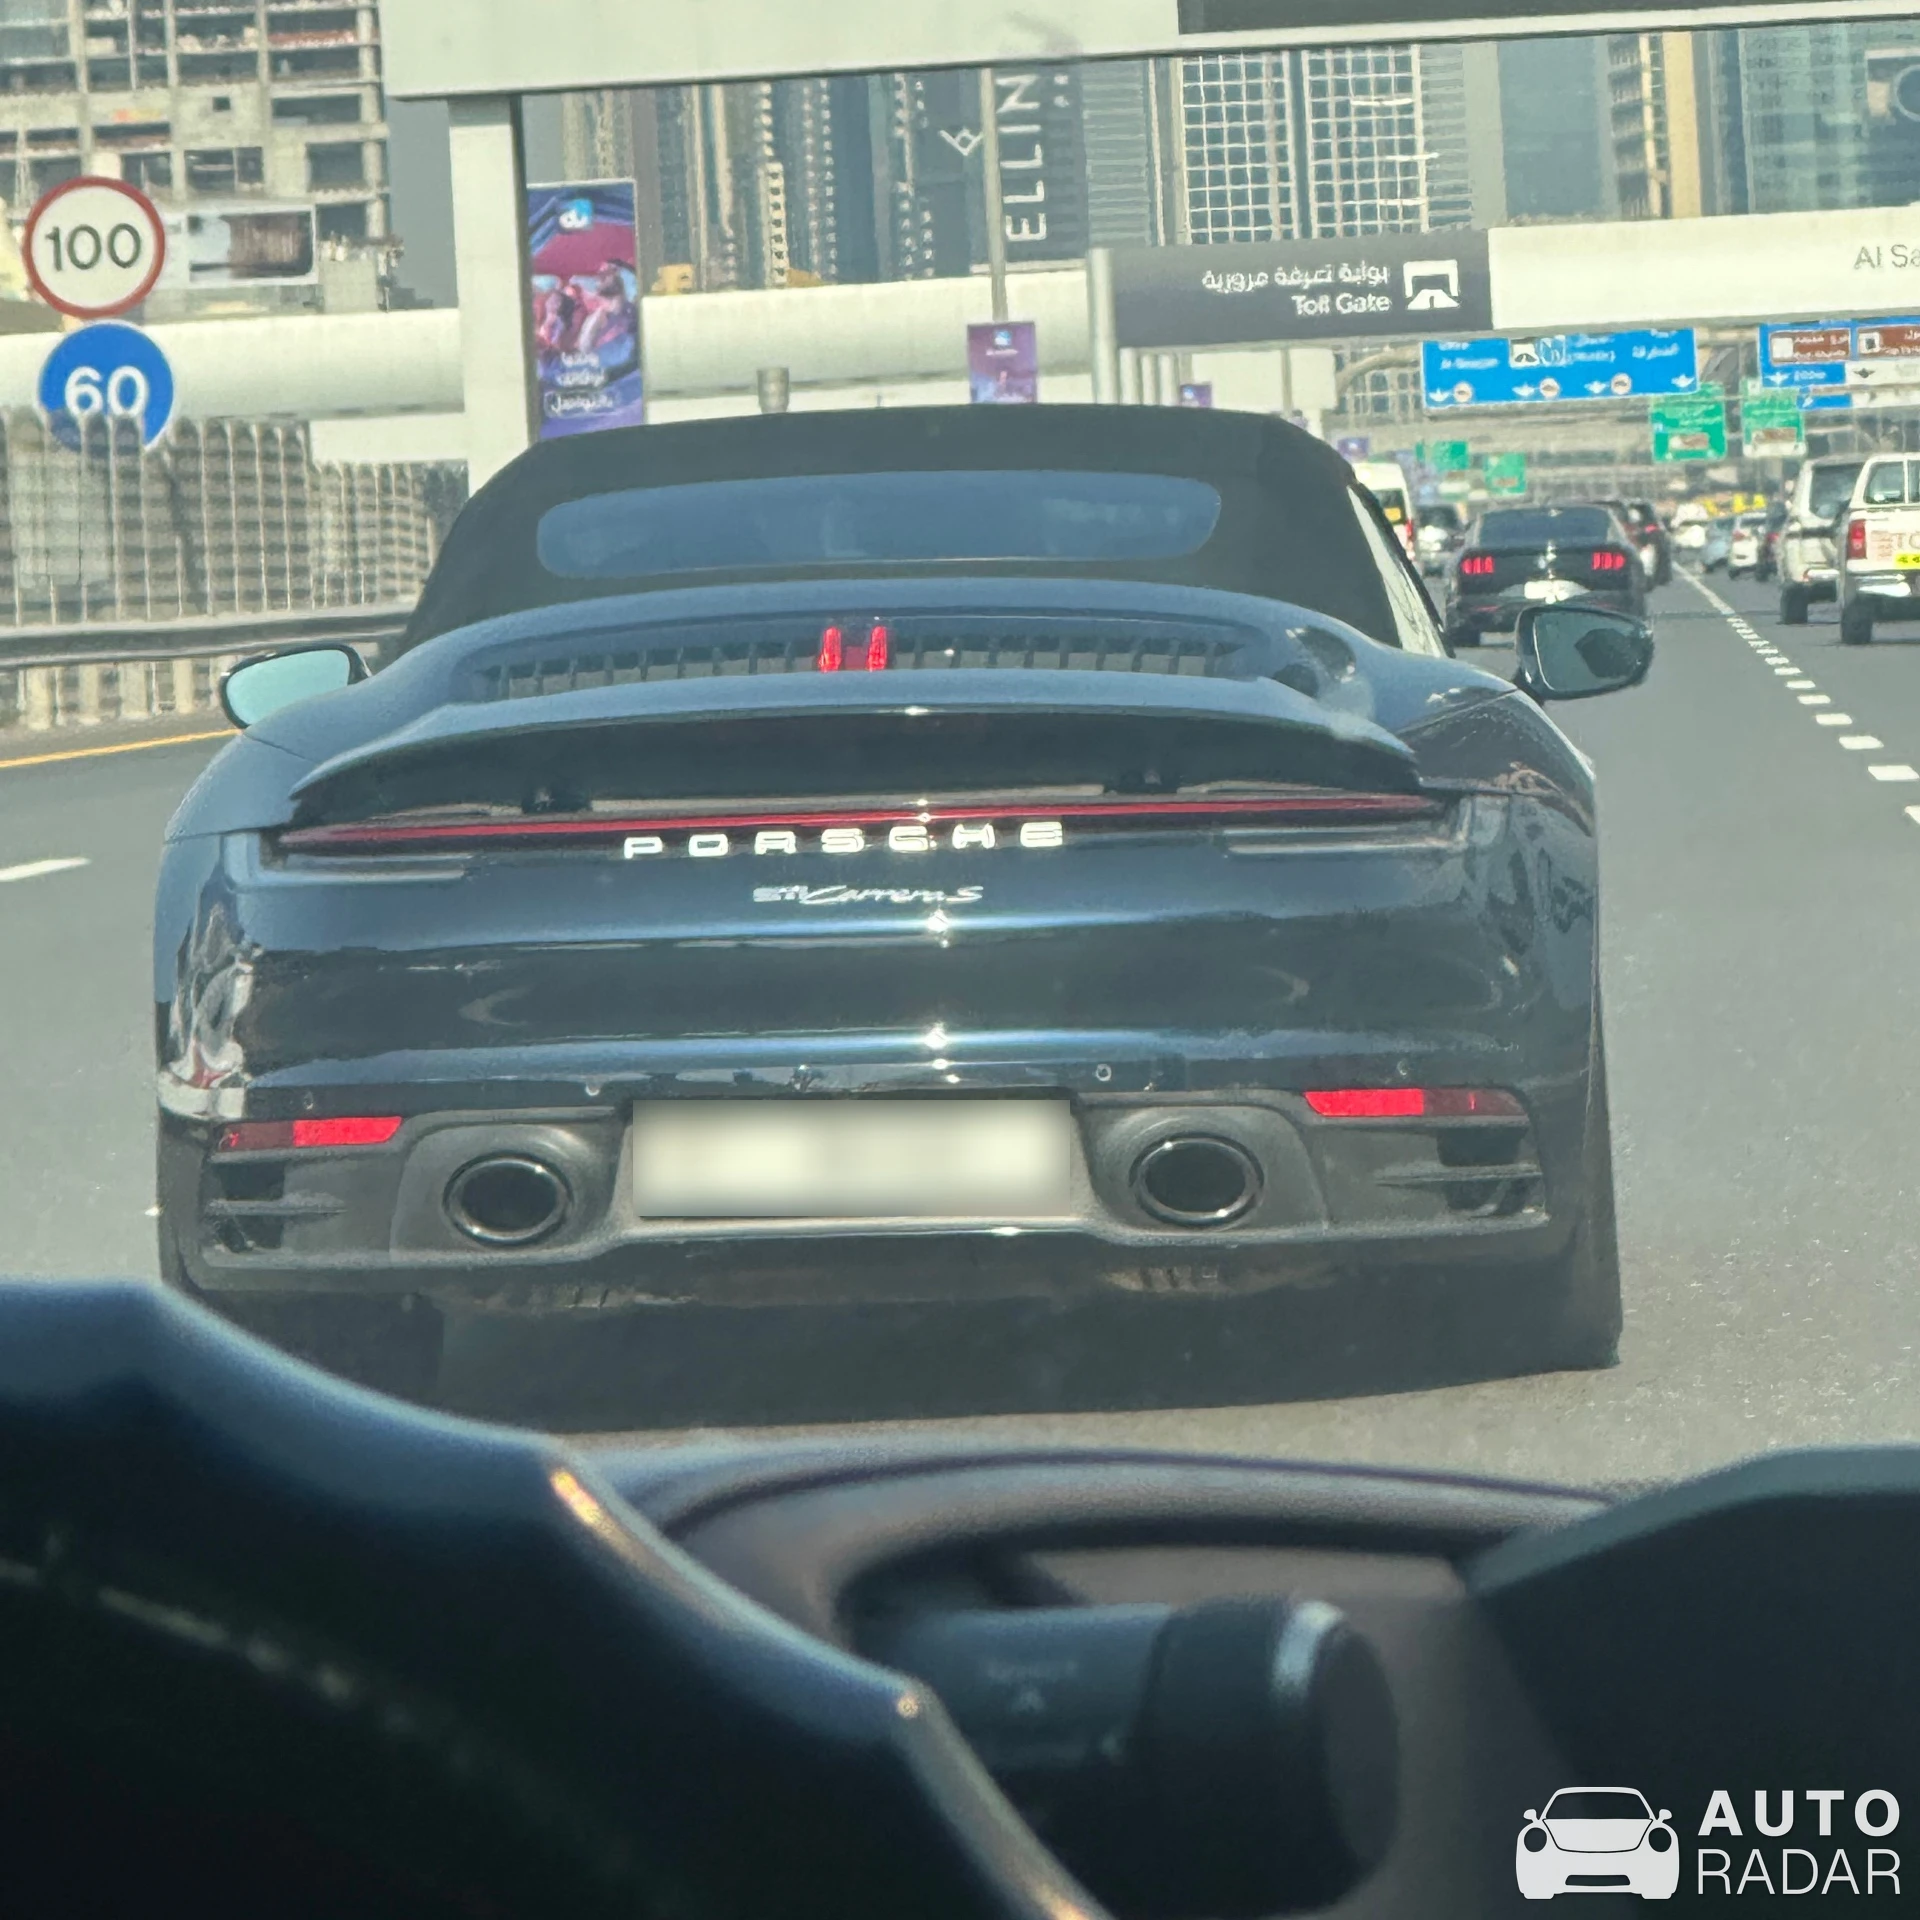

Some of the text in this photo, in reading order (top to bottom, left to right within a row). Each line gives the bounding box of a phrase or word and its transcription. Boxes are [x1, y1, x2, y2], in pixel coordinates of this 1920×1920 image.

[45, 222, 142, 272] 100
[1853, 245, 1881, 269] Al
[1292, 292, 1391, 316] Toll Gate
[65, 365, 149, 420] 60
[623, 820, 1064, 860] PORSCHE
[946, 885, 984, 903] S
